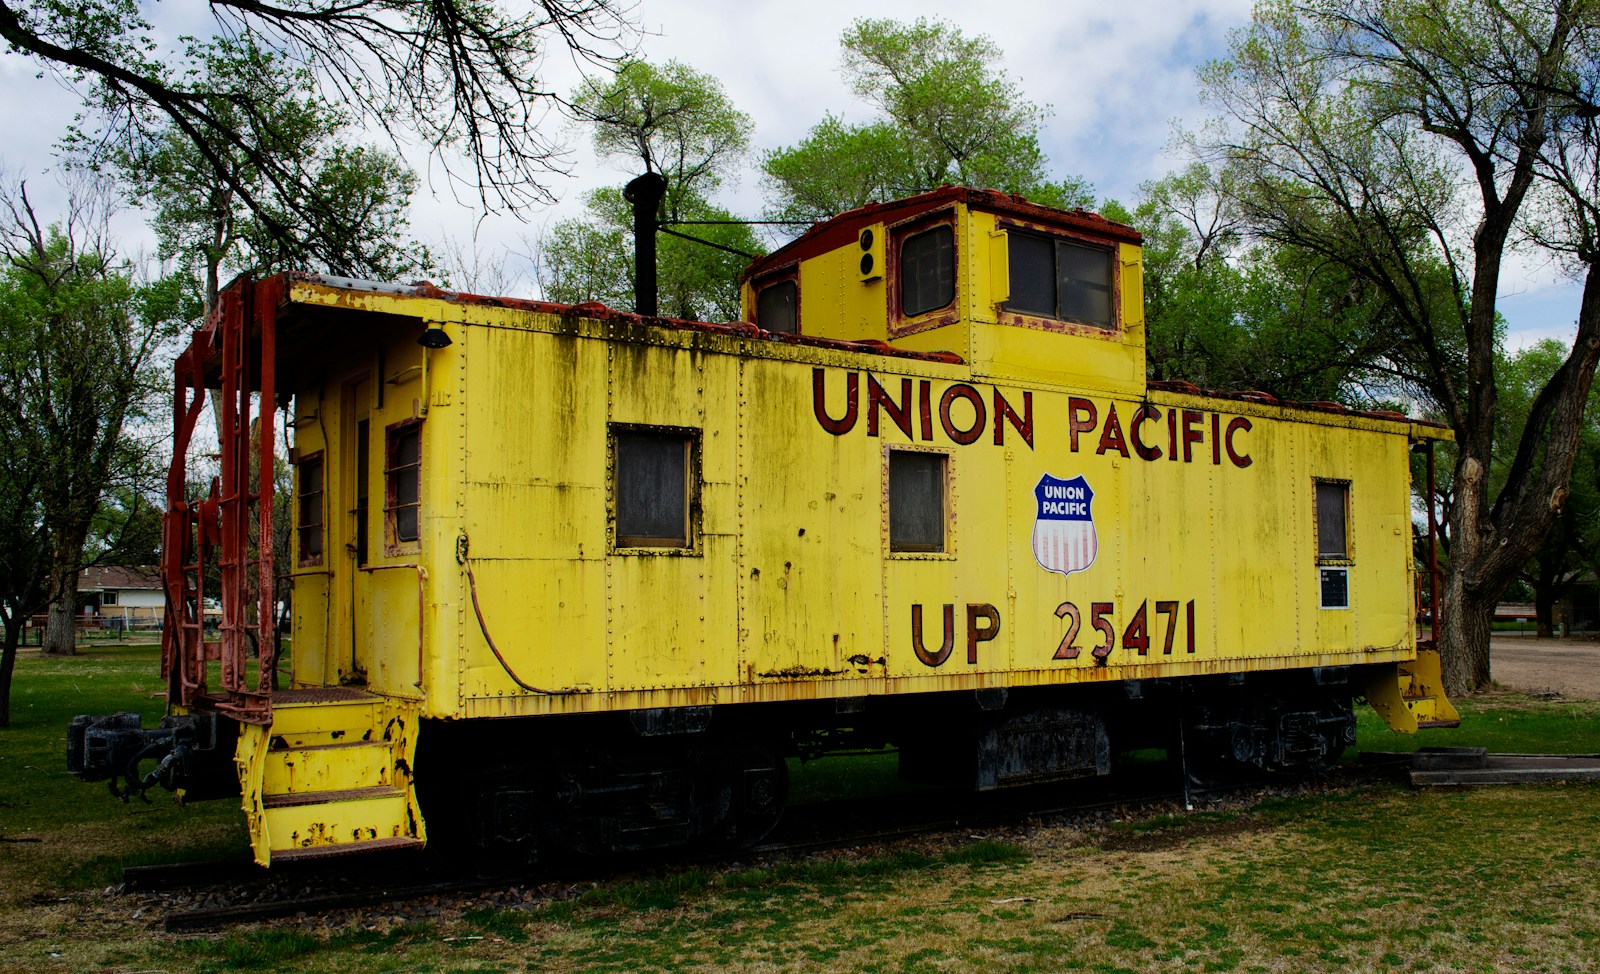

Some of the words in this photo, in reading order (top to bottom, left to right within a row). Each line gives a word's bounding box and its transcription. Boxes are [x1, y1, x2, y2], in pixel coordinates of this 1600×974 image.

[812, 367, 1034, 451] UNION
[1068, 396, 1253, 468] PACIFIC
[1042, 501, 1087, 515] PACIFIC
[1044, 485, 1084, 500] UNION
[911, 603, 1000, 667] UP
[1052, 598, 1196, 660] 25471
